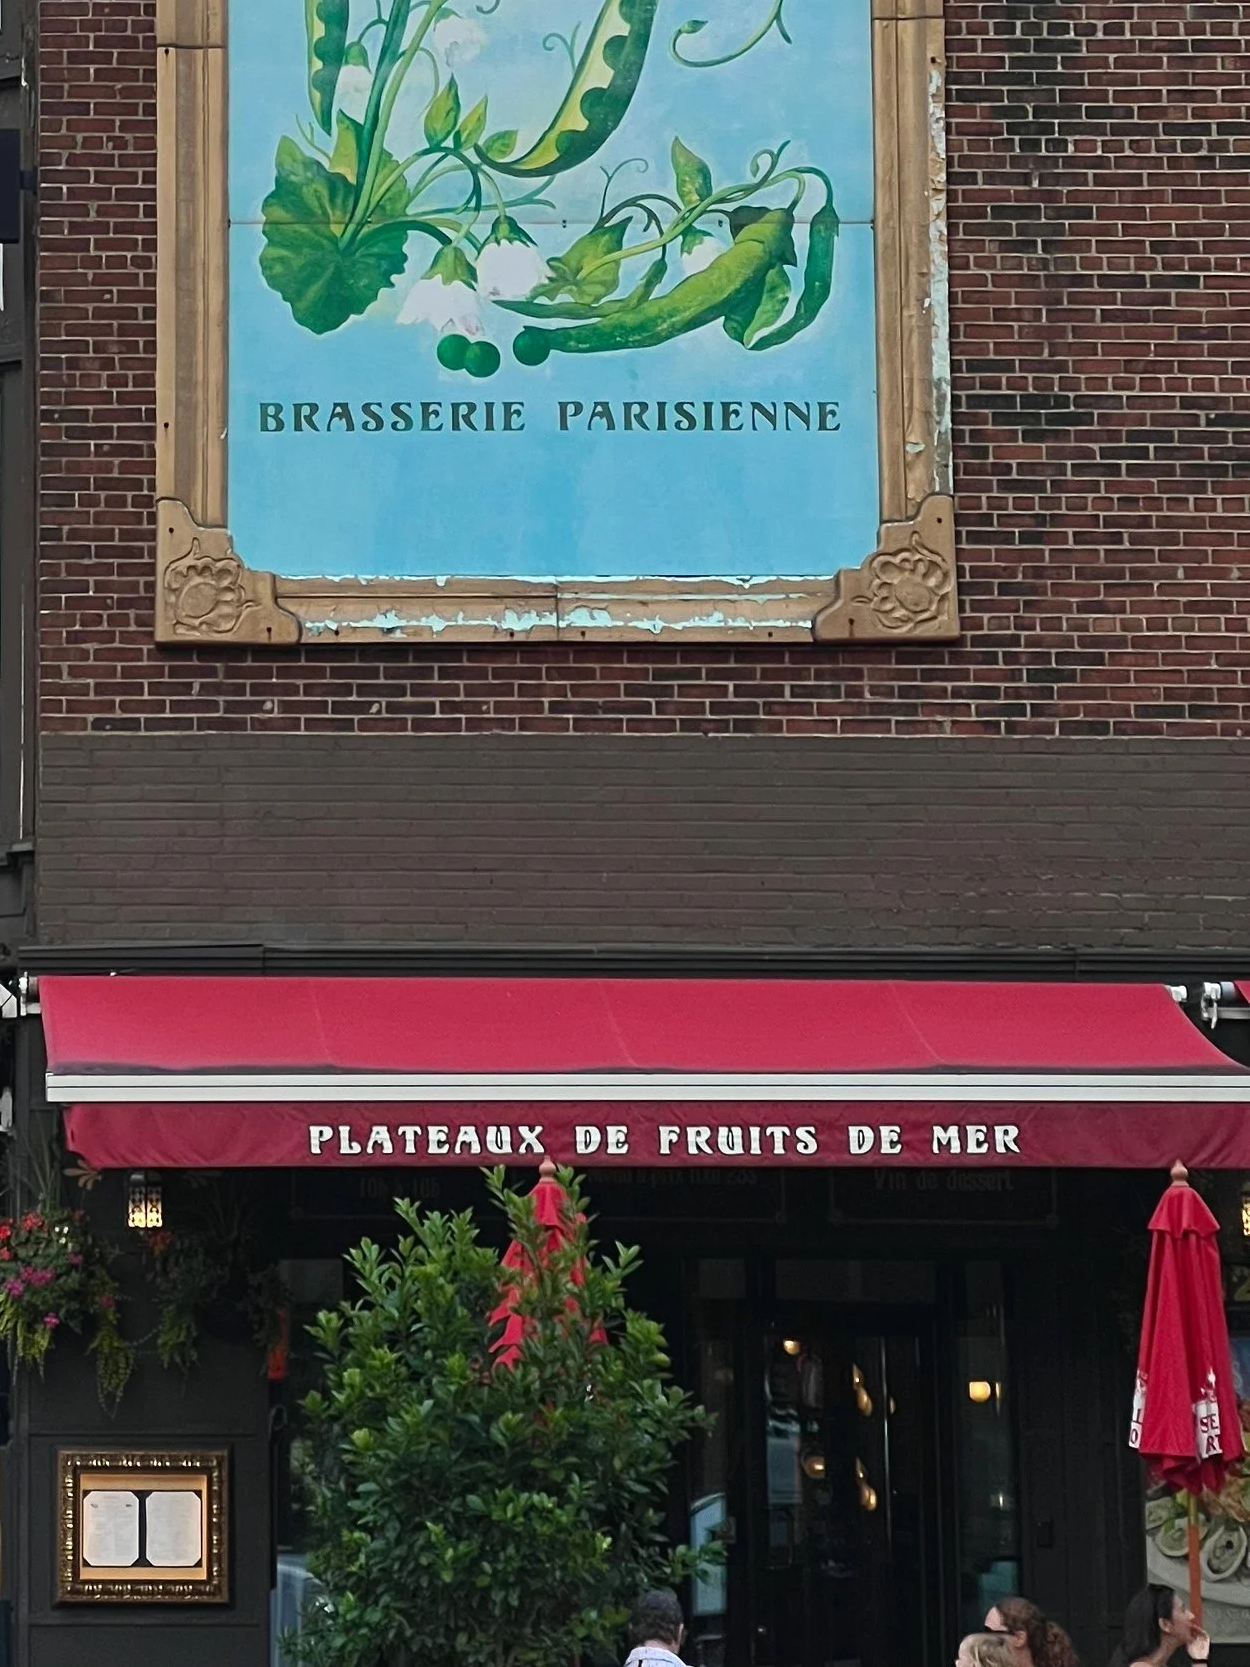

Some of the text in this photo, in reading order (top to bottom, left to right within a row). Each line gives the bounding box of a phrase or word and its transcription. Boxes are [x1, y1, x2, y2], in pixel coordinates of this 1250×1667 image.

[258, 400, 842, 433] BRASSERIE PARISIENNE
[308, 1123, 1022, 1156] PLATEAUX DE FRUITS DE MER
